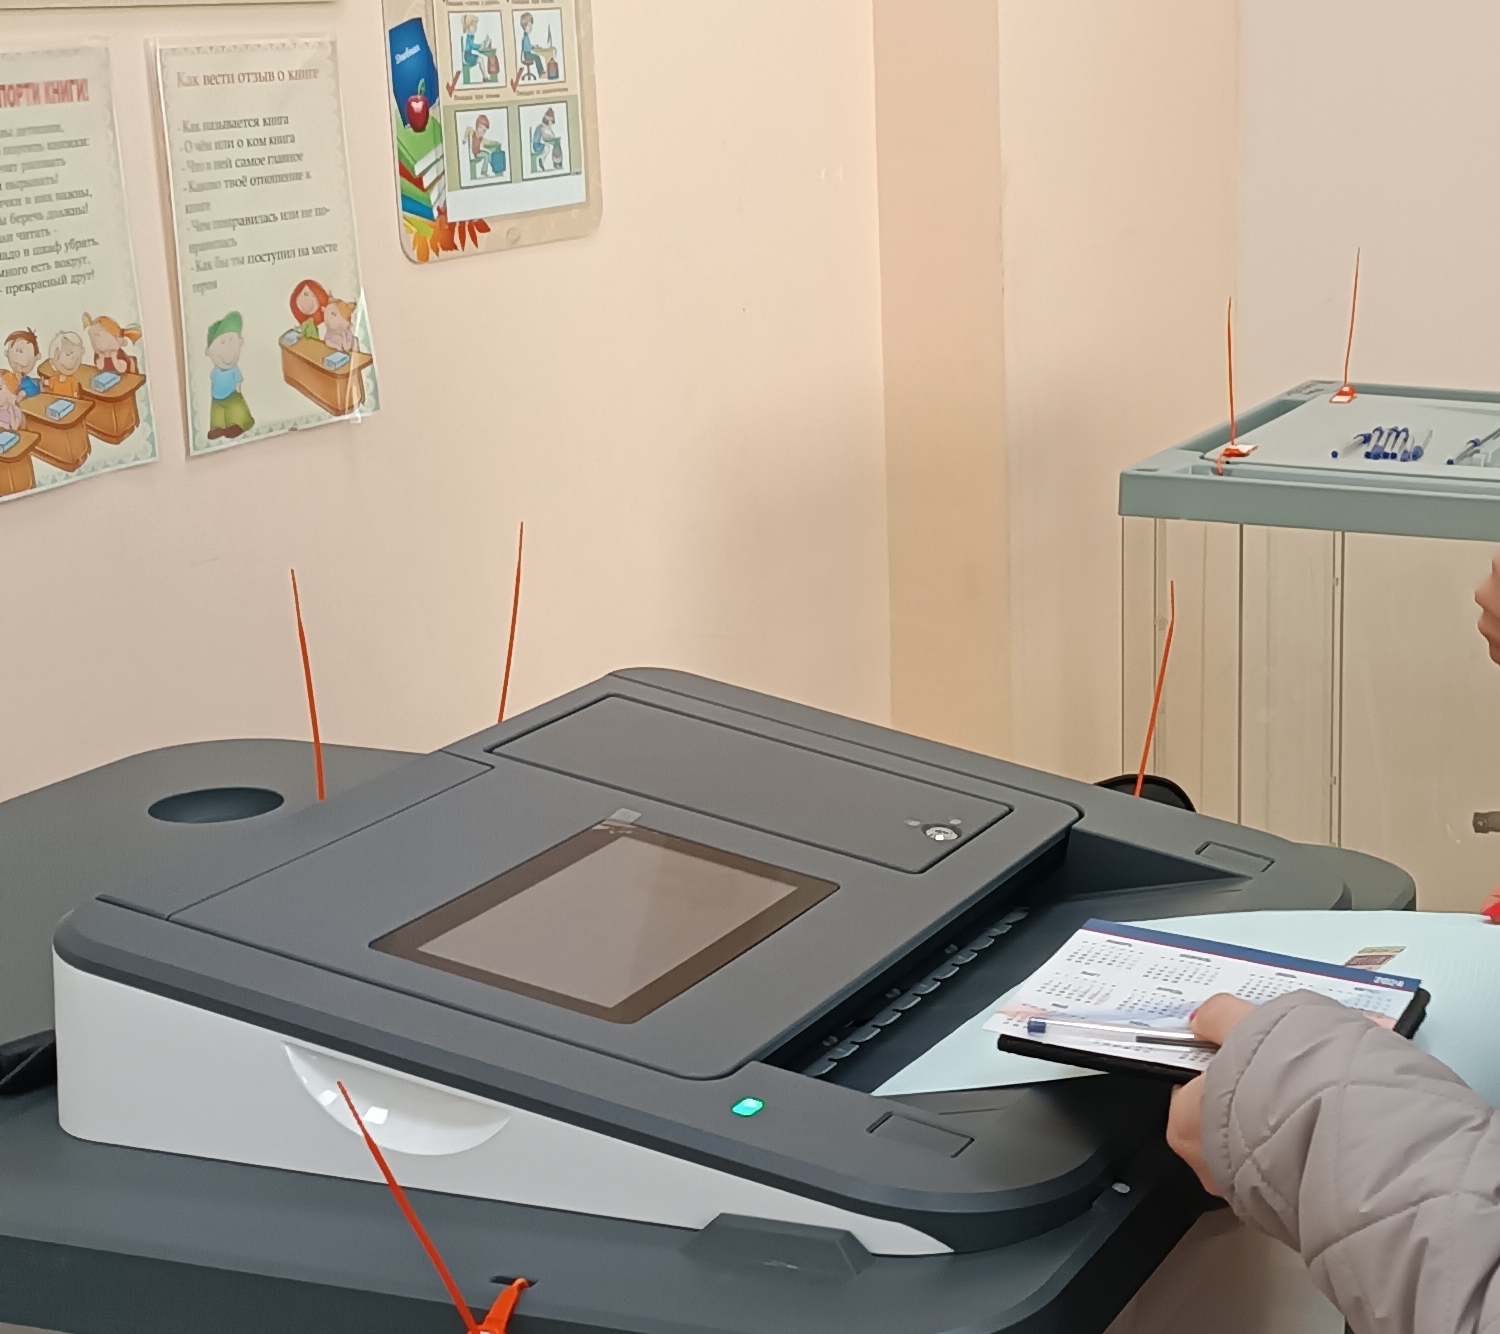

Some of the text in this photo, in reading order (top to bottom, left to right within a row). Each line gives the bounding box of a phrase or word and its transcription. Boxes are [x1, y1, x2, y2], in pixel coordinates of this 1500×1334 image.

[203, 72, 235, 85] вести
[237, 71, 275, 84] отзыв
[277, 70, 285, 81] о
[247, 137, 266, 148] ком
[235, 156, 266, 168] самое
[247, 249, 296, 266] поступил
[312, 243, 338, 255] месте
[5, 274, 68, 296] прекрасный
